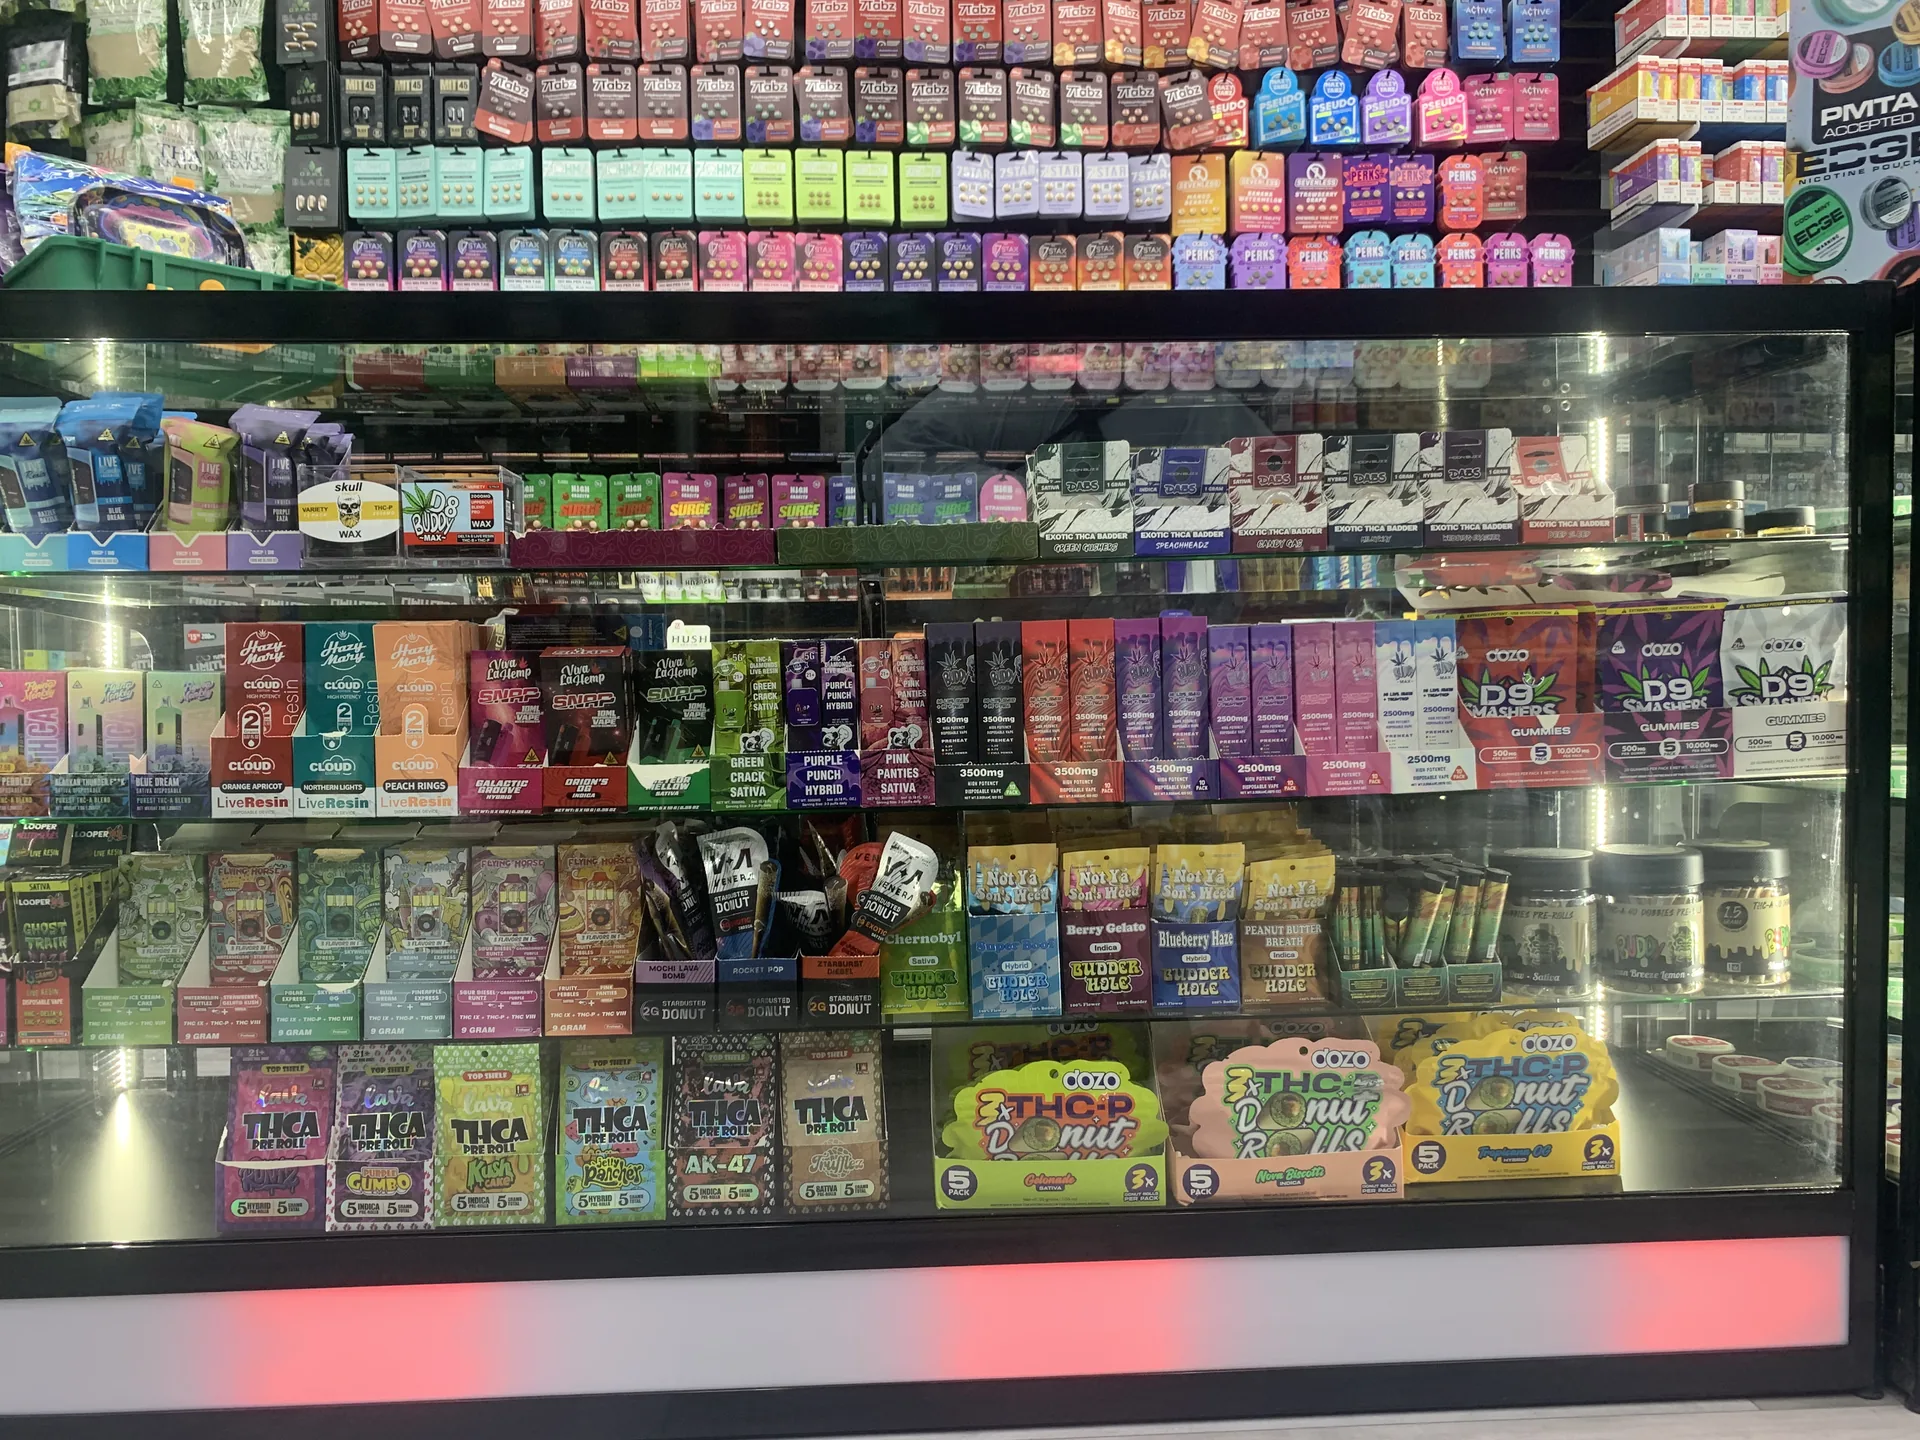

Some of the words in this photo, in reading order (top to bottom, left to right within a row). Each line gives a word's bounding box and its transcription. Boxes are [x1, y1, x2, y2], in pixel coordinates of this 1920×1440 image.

[1466, 7, 1493, 15] ACTIVE
[282, 13, 318, 22] BLACK
[365, 80, 374, 90] 45
[697, 79, 734, 92] 7Tabz
[1259, 92, 1303, 110] PSEUDO
[1422, 95, 1465, 110] PSEUDO
[1821, 92, 1918, 126] PMTA
[1823, 113, 1915, 139] ACCEPTED
[1799, 169, 1865, 185] NICOTINE
[1794, 212, 1813, 227] COOL
[1814, 202, 1831, 215] MINT
[1793, 208, 1845, 245] EDGE
[1816, 234, 1840, 251] WARNING
[1185, 250, 1215, 261] PERKS
[1245, 250, 1274, 261] PERKS
[98, 456, 117, 468] LIVE
[1258, 474, 1291, 485] DABS
[335, 483, 362, 492] skull
[1066, 481, 1098, 491] DABS
[429, 490, 459, 518] D8
[670, 503, 711, 516] SURGE
[729, 503, 764, 518] SURGE
[106, 513, 125, 521] DREAM
[411, 512, 456, 535] BUDDY
[471, 520, 491, 528] WAX
[1156, 541, 1209, 549] SPEACHHEADZ
[1286, 539, 1303, 548] GAS
[671, 635, 708, 643] HUSH
[240, 640, 286, 656] Hazy
[240, 652, 285, 666] Mary
[804, 652, 815, 660] 5G
[489, 659, 517, 671] Viva
[753, 682, 777, 690] GREEN
[1761, 674, 1814, 698] D9
[478, 687, 541, 705] SNAP
[753, 692, 778, 700] CRACK
[1480, 684, 1534, 706] D9
[283, 680, 299, 726] Resin
[244, 713, 259, 729] 2
[1766, 713, 1826, 726] GUMMIES
[1512, 727, 1571, 737] GUMMIES
[731, 757, 764, 768] GREEN
[804, 755, 843, 766] PURPLE
[886, 754, 909, 765] PINK
[1408, 754, 1451, 765] 2500mg
[228, 761, 272, 771] CLOUD
[310, 762, 352, 772] CLOUD
[1054, 767, 1098, 777] 3500mg
[1237, 763, 1282, 774] 2500mg
[730, 772, 765, 783] CRACK
[807, 770, 841, 781] PUNCH
[877, 768, 919, 779] PANTIES
[960, 768, 1004, 779] 3500mg
[252, 782, 282, 790] APRICOT
[385, 782, 416, 790] PEACH
[418, 782, 445, 790] RINGS
[475, 779, 529, 788] GALACTIC
[565, 778, 608, 786] ORION'S
[478, 786, 522, 794] GROOVE
[730, 787, 766, 798] SATIVA
[805, 784, 843, 796] HYBRID
[880, 783, 916, 794] SATIVA
[218, 796, 288, 809] LiveResin
[716, 897, 750, 913] DONUT
[1724, 904, 1741, 918] 1.5
[1533, 911, 1574, 919] PRE-ROLLS
[24, 922, 67, 934] GHOST
[865, 922, 888, 936] EXOTIC
[1066, 924, 1103, 937] Berry
[1106, 921, 1146, 934] Gelato
[1244, 924, 1284, 936] PEANUT
[1286, 922, 1322, 935] BUTTER
[25, 937, 67, 950] TRAIN
[884, 930, 961, 945] Chernobyl
[1158, 929, 1209, 949] Blueberry
[1211, 931, 1233, 946] Haze
[1265, 936, 1304, 947] BREATH
[1093, 943, 1118, 952] Indica
[912, 957, 936, 965] Sativa
[1004, 961, 1029, 971] Hybrid
[733, 967, 764, 975] ROCKET
[1070, 960, 1142, 978] BUDDER
[1630, 969, 1658, 978] Breeze
[1660, 970, 1686, 980] Lemon
[662, 972, 686, 980] BOMB
[1086, 977, 1132, 993] HOLE
[642, 1006, 659, 1017] 2G
[829, 1003, 871, 1015] DONUT
[186, 1032, 191, 1040] 9
[193, 1032, 219, 1040] GRAM
[468, 1073, 482, 1081] TOP
[483, 1072, 508, 1080] SHELF
[573, 1105, 649, 1134] THCA
[688, 1101, 763, 1127] THCA
[243, 1111, 321, 1140] THCA
[347, 1112, 427, 1141] THCA
[451, 1118, 529, 1145] THCA
[252, 1140, 271, 1151] PRE
[273, 1139, 306, 1150] ROLL
[1478, 1145, 1529, 1161] Tropicana
[1531, 1145, 1553, 1157] OG
[684, 1154, 757, 1175] AK-47
[808, 1156, 865, 1177] Trufflez
[466, 1158, 515, 1191] Kush
[949, 1170, 971, 1191] 5
[1256, 1169, 1283, 1184] Nova
[1284, 1166, 1325, 1181] Biscotti
[346, 1176, 412, 1196] GUMBO
[948, 1188, 970, 1196] PACK
[1190, 1188, 1212, 1196] PACK
